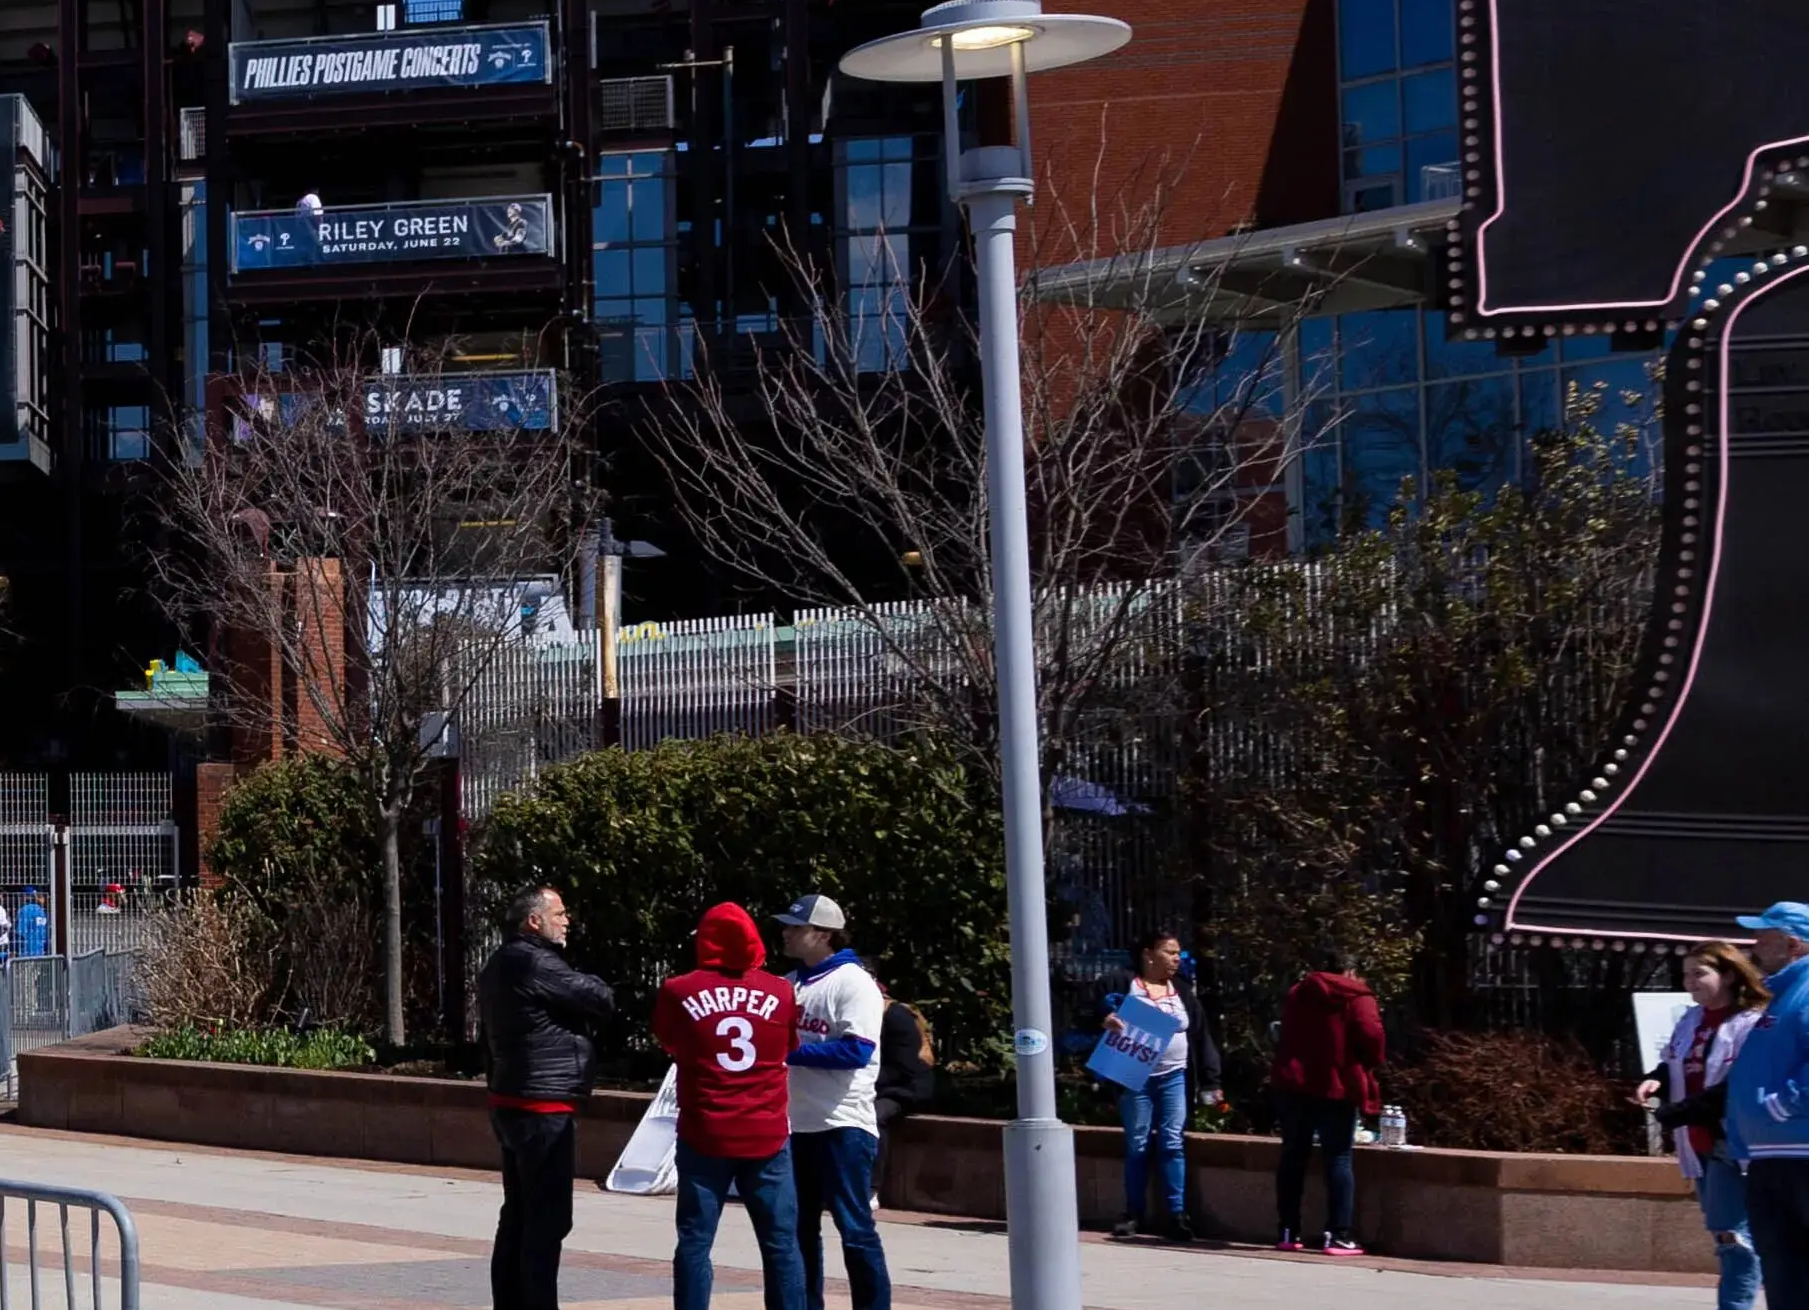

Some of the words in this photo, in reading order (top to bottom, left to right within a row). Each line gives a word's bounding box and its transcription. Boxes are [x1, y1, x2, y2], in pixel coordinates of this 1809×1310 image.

[244, 53, 313, 89] PHILLIES
[312, 47, 399, 85] POSTGAME
[399, 43, 482, 81] CONCERTS
[317, 219, 386, 243] RILEY
[394, 214, 469, 238] GREEN
[321, 240, 399, 255] SATURDAY,
[402, 238, 438, 249] JUNE
[442, 236, 462, 248] 22
[682, 986, 780, 1022] HARPER
[715, 1016, 757, 1073] 3
